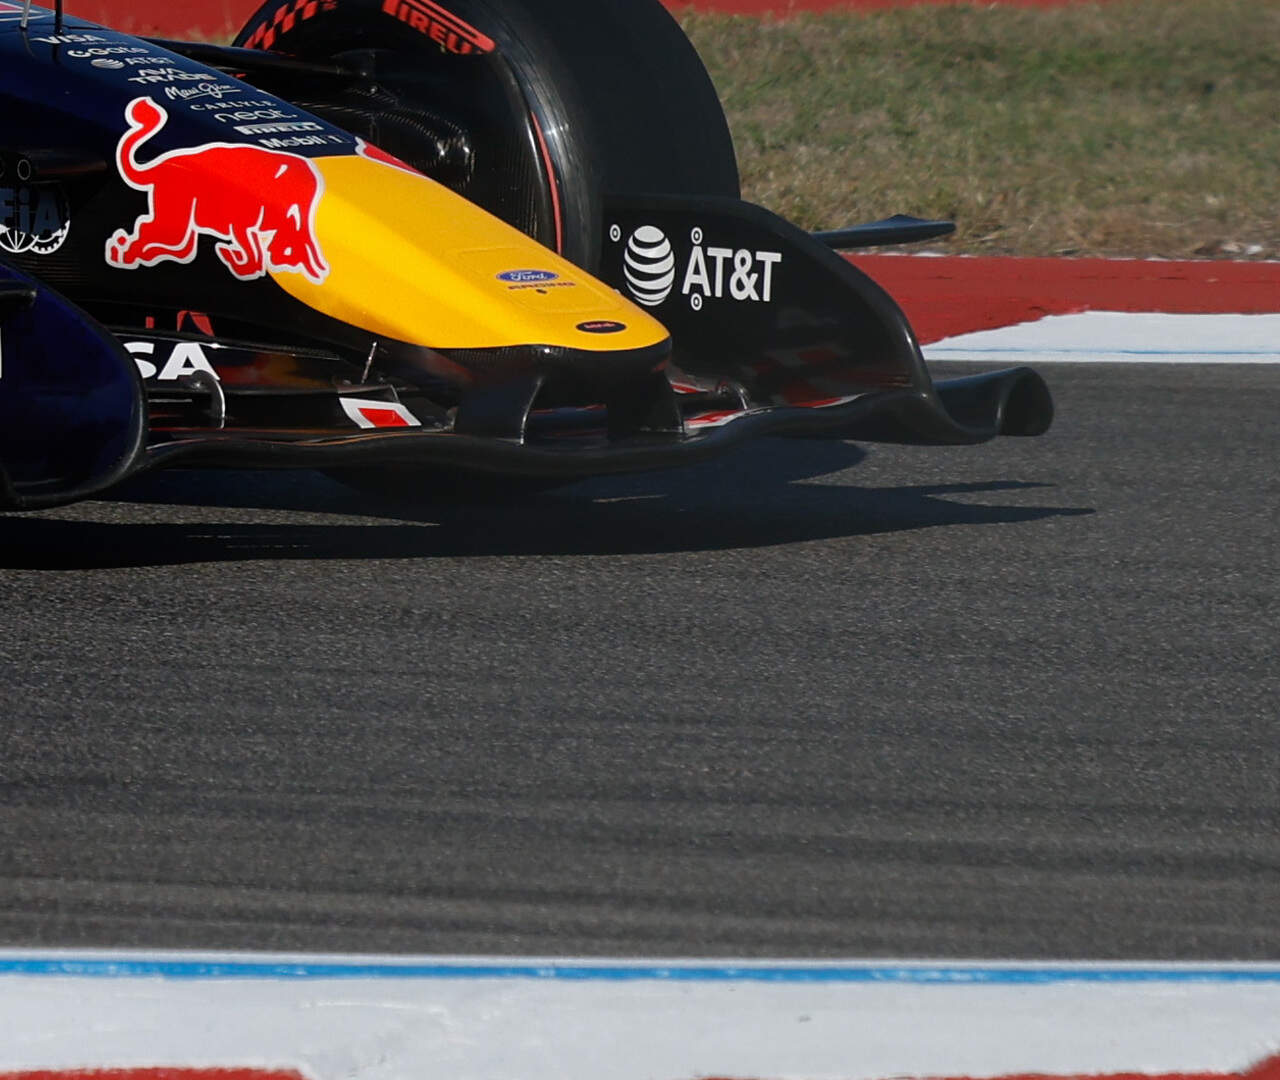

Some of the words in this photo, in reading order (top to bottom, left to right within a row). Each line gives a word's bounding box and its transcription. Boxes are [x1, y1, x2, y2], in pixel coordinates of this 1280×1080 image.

[31, 34, 106, 45] VISA
[190, 100, 278, 111] CARLYLE
[233, 122, 325, 135] PIRELLI
[258, 135, 324, 149] Mobil
[682, 246, 782, 303] AT&T
[130, 342, 222, 381] SA
